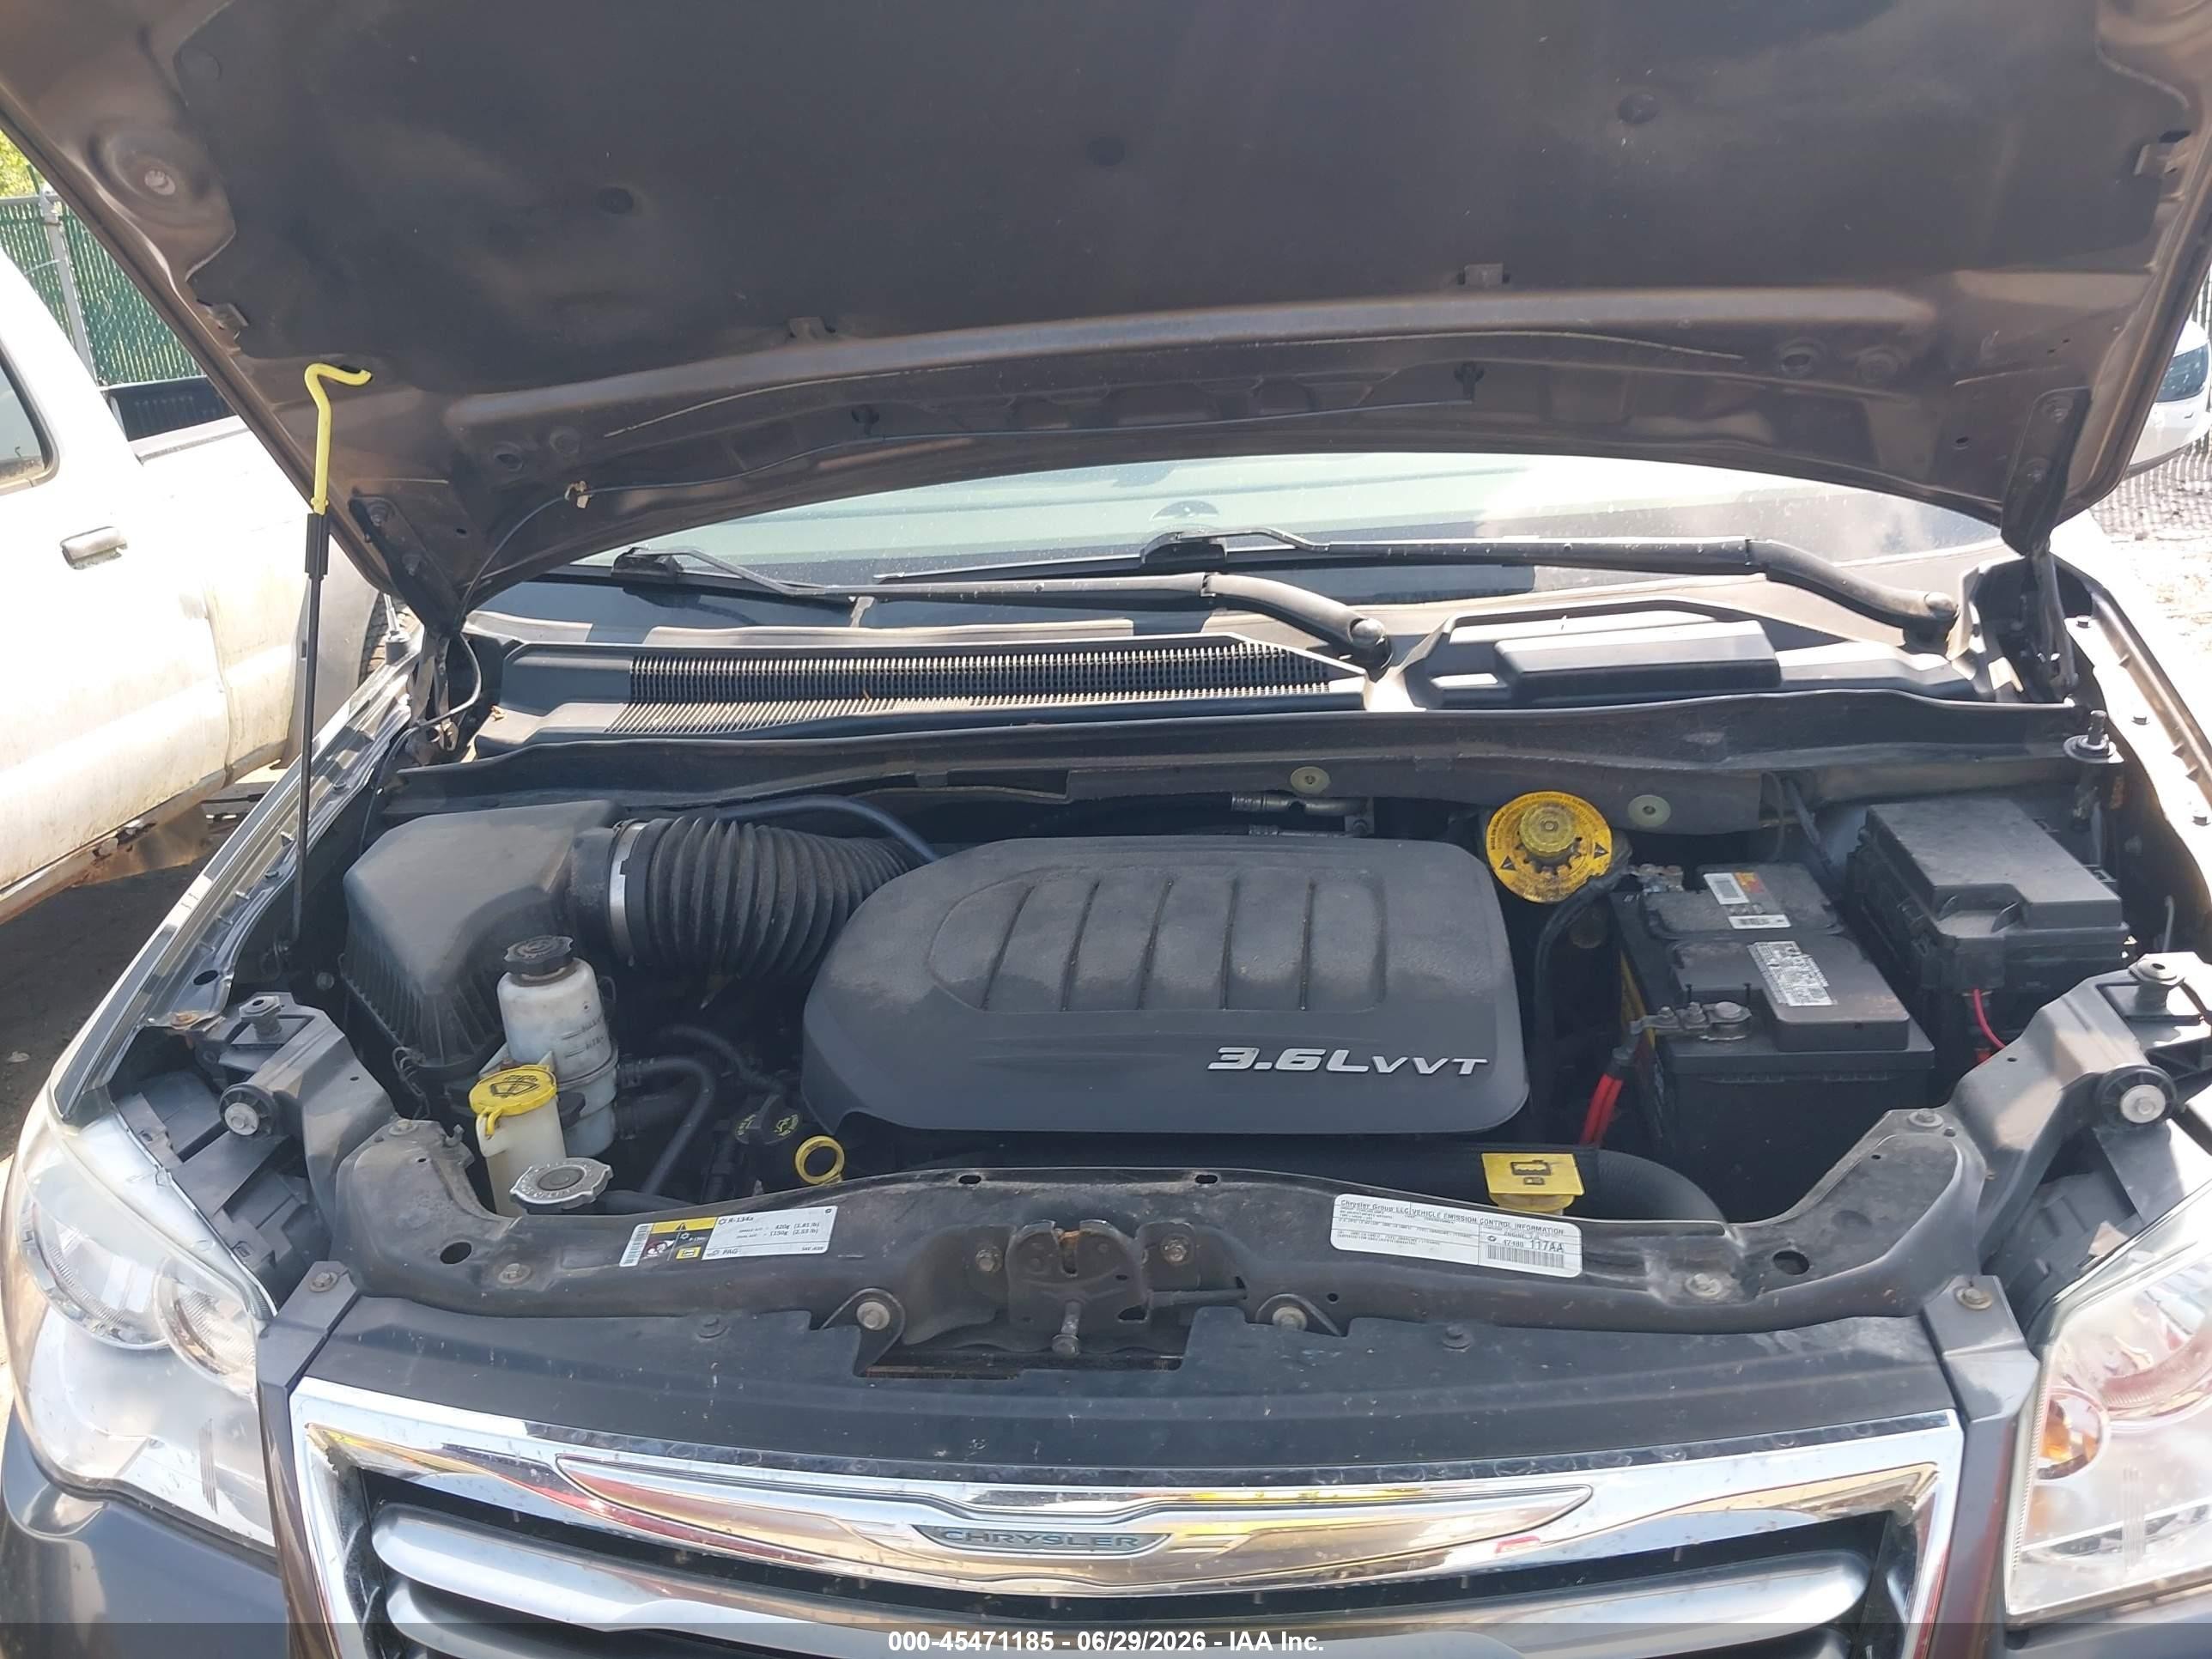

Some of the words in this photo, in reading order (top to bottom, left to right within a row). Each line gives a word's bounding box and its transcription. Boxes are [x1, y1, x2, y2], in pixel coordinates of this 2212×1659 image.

[1340, 1200, 1369, 1210] Chrysler
[1372, 1203, 1394, 1213] Group
[1412, 1209, 1441, 1218] VEHICLE
[1443, 1212, 1477, 1223] EMISSION
[1480, 1218, 1510, 1228] CONTROL
[1514, 1223, 1564, 1235] INFORMATION
[1530, 1239, 1564, 1253] 117AA
[945, 1530, 1139, 1547] CHRYSLER
